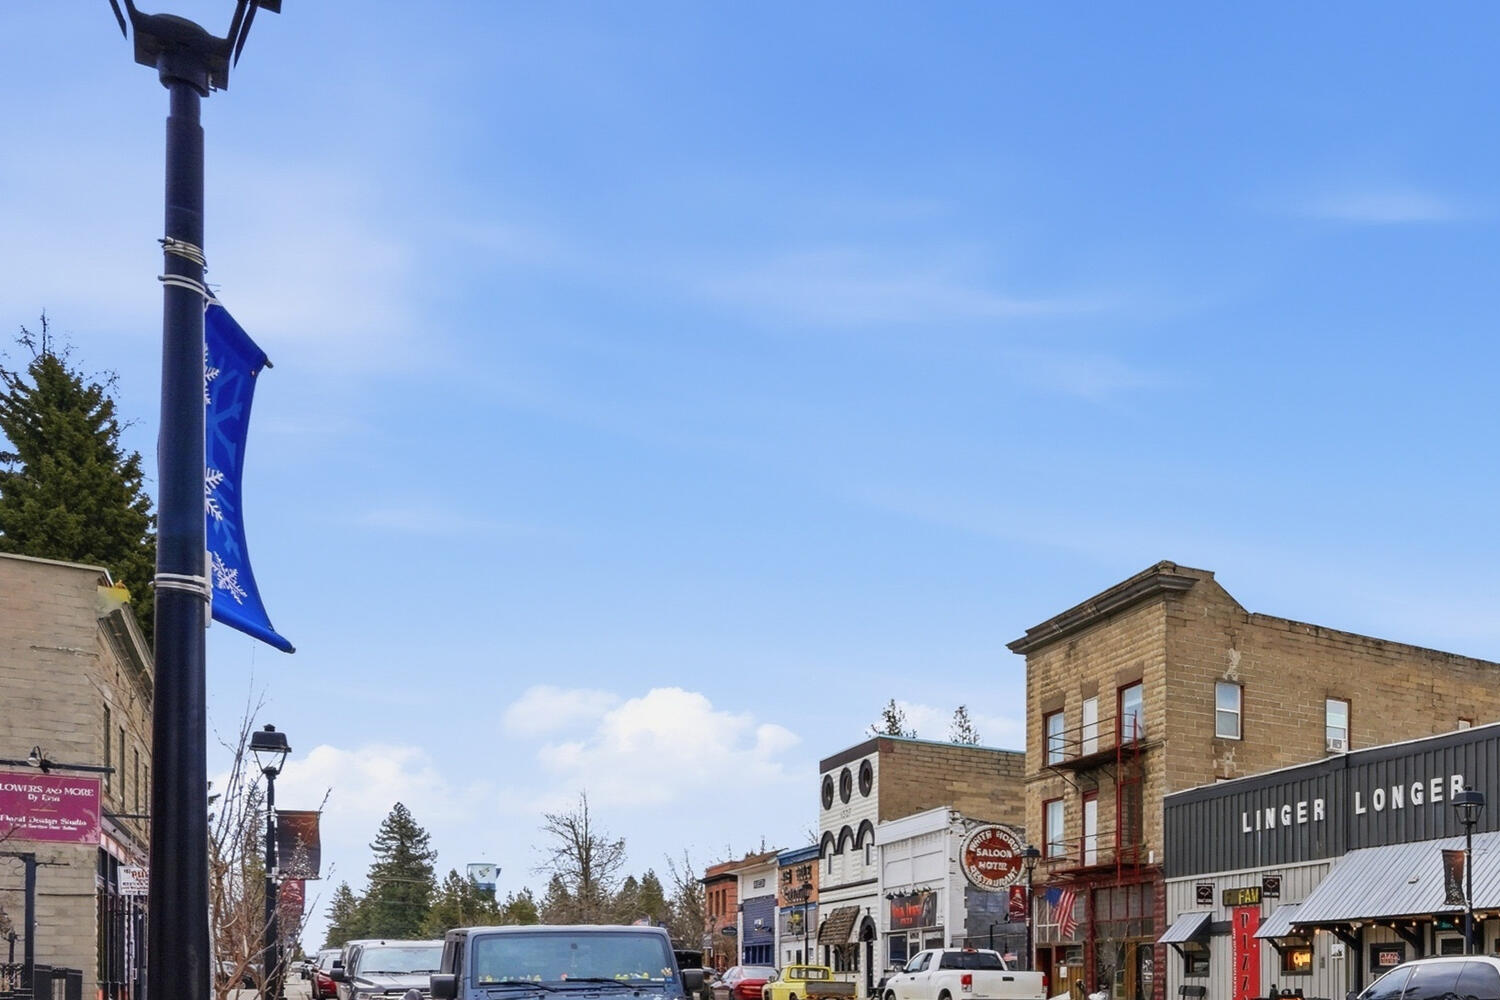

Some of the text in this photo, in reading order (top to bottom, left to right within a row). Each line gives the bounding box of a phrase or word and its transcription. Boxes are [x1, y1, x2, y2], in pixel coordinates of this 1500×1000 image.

[0, 783, 43, 794] LOWERS
[64, 787, 94, 797] MORE
[1242, 774, 1464, 833] LINGER LONGER
[976, 848, 1013, 858] SALOON
[978, 861, 1008, 871] HOTEL
